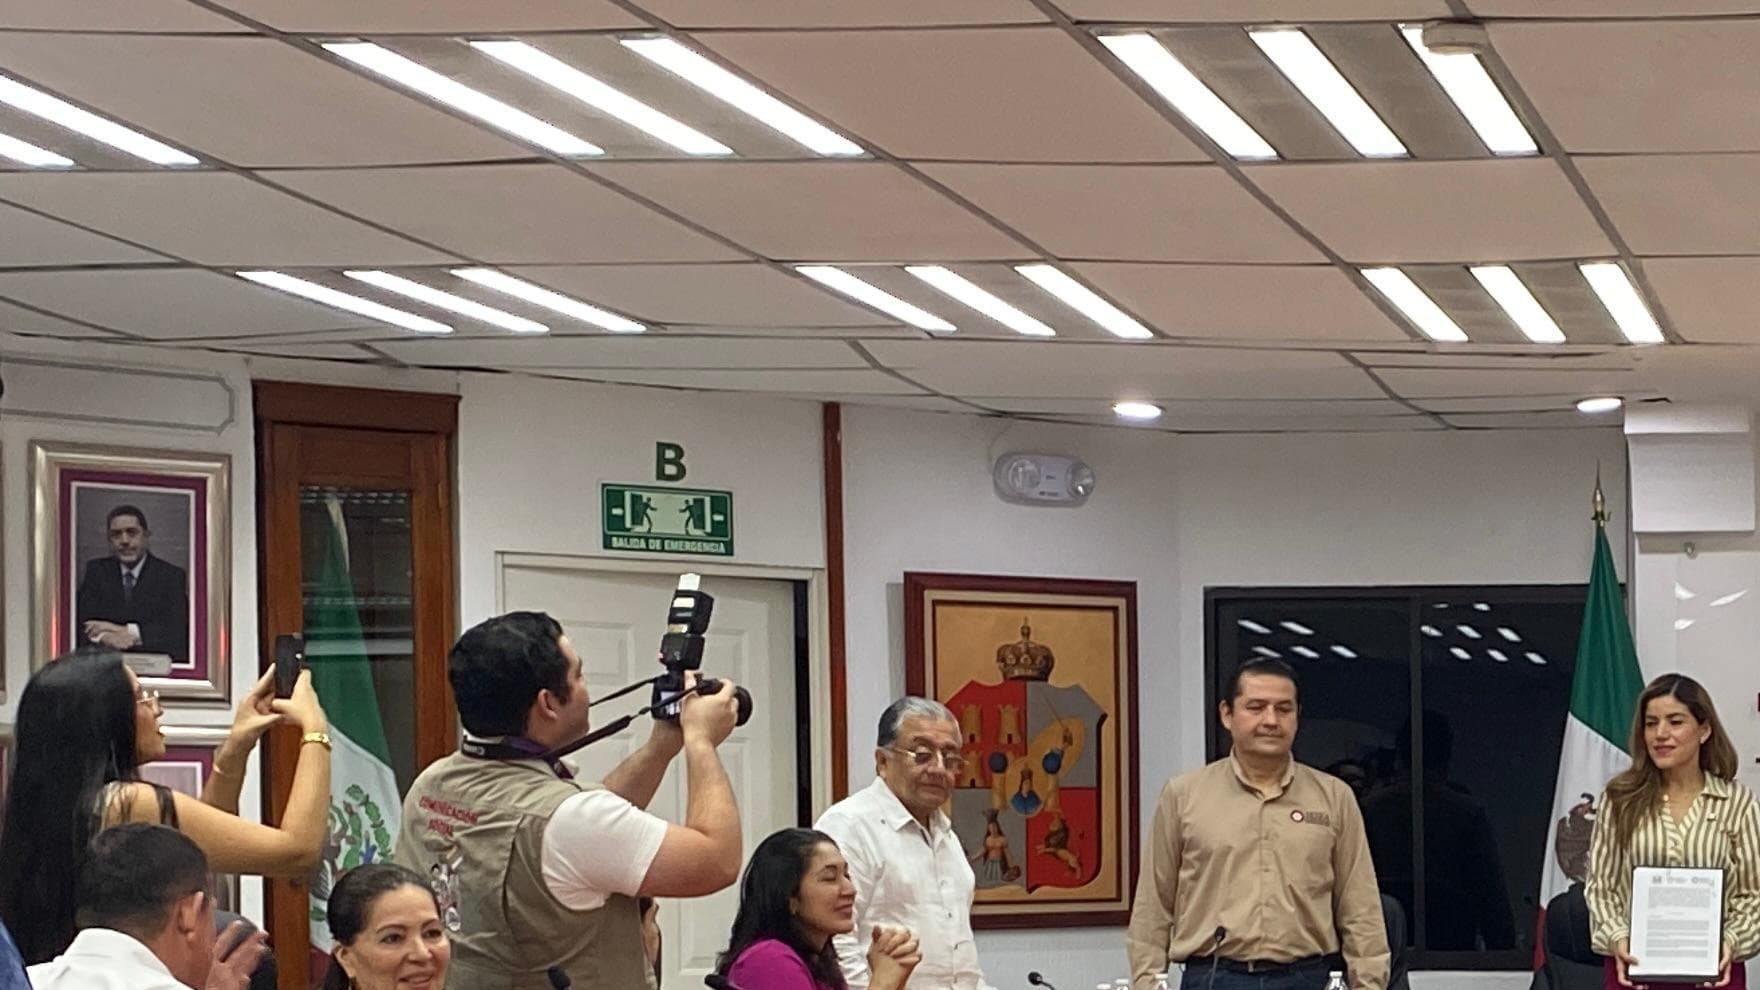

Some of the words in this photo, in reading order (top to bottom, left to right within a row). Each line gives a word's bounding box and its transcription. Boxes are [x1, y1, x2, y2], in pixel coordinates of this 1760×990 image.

[656, 441, 687, 481] B
[611, 537, 646, 550] SALIDA
[648, 539, 662, 550] DE
[664, 540, 726, 553] EMERGENCIA
